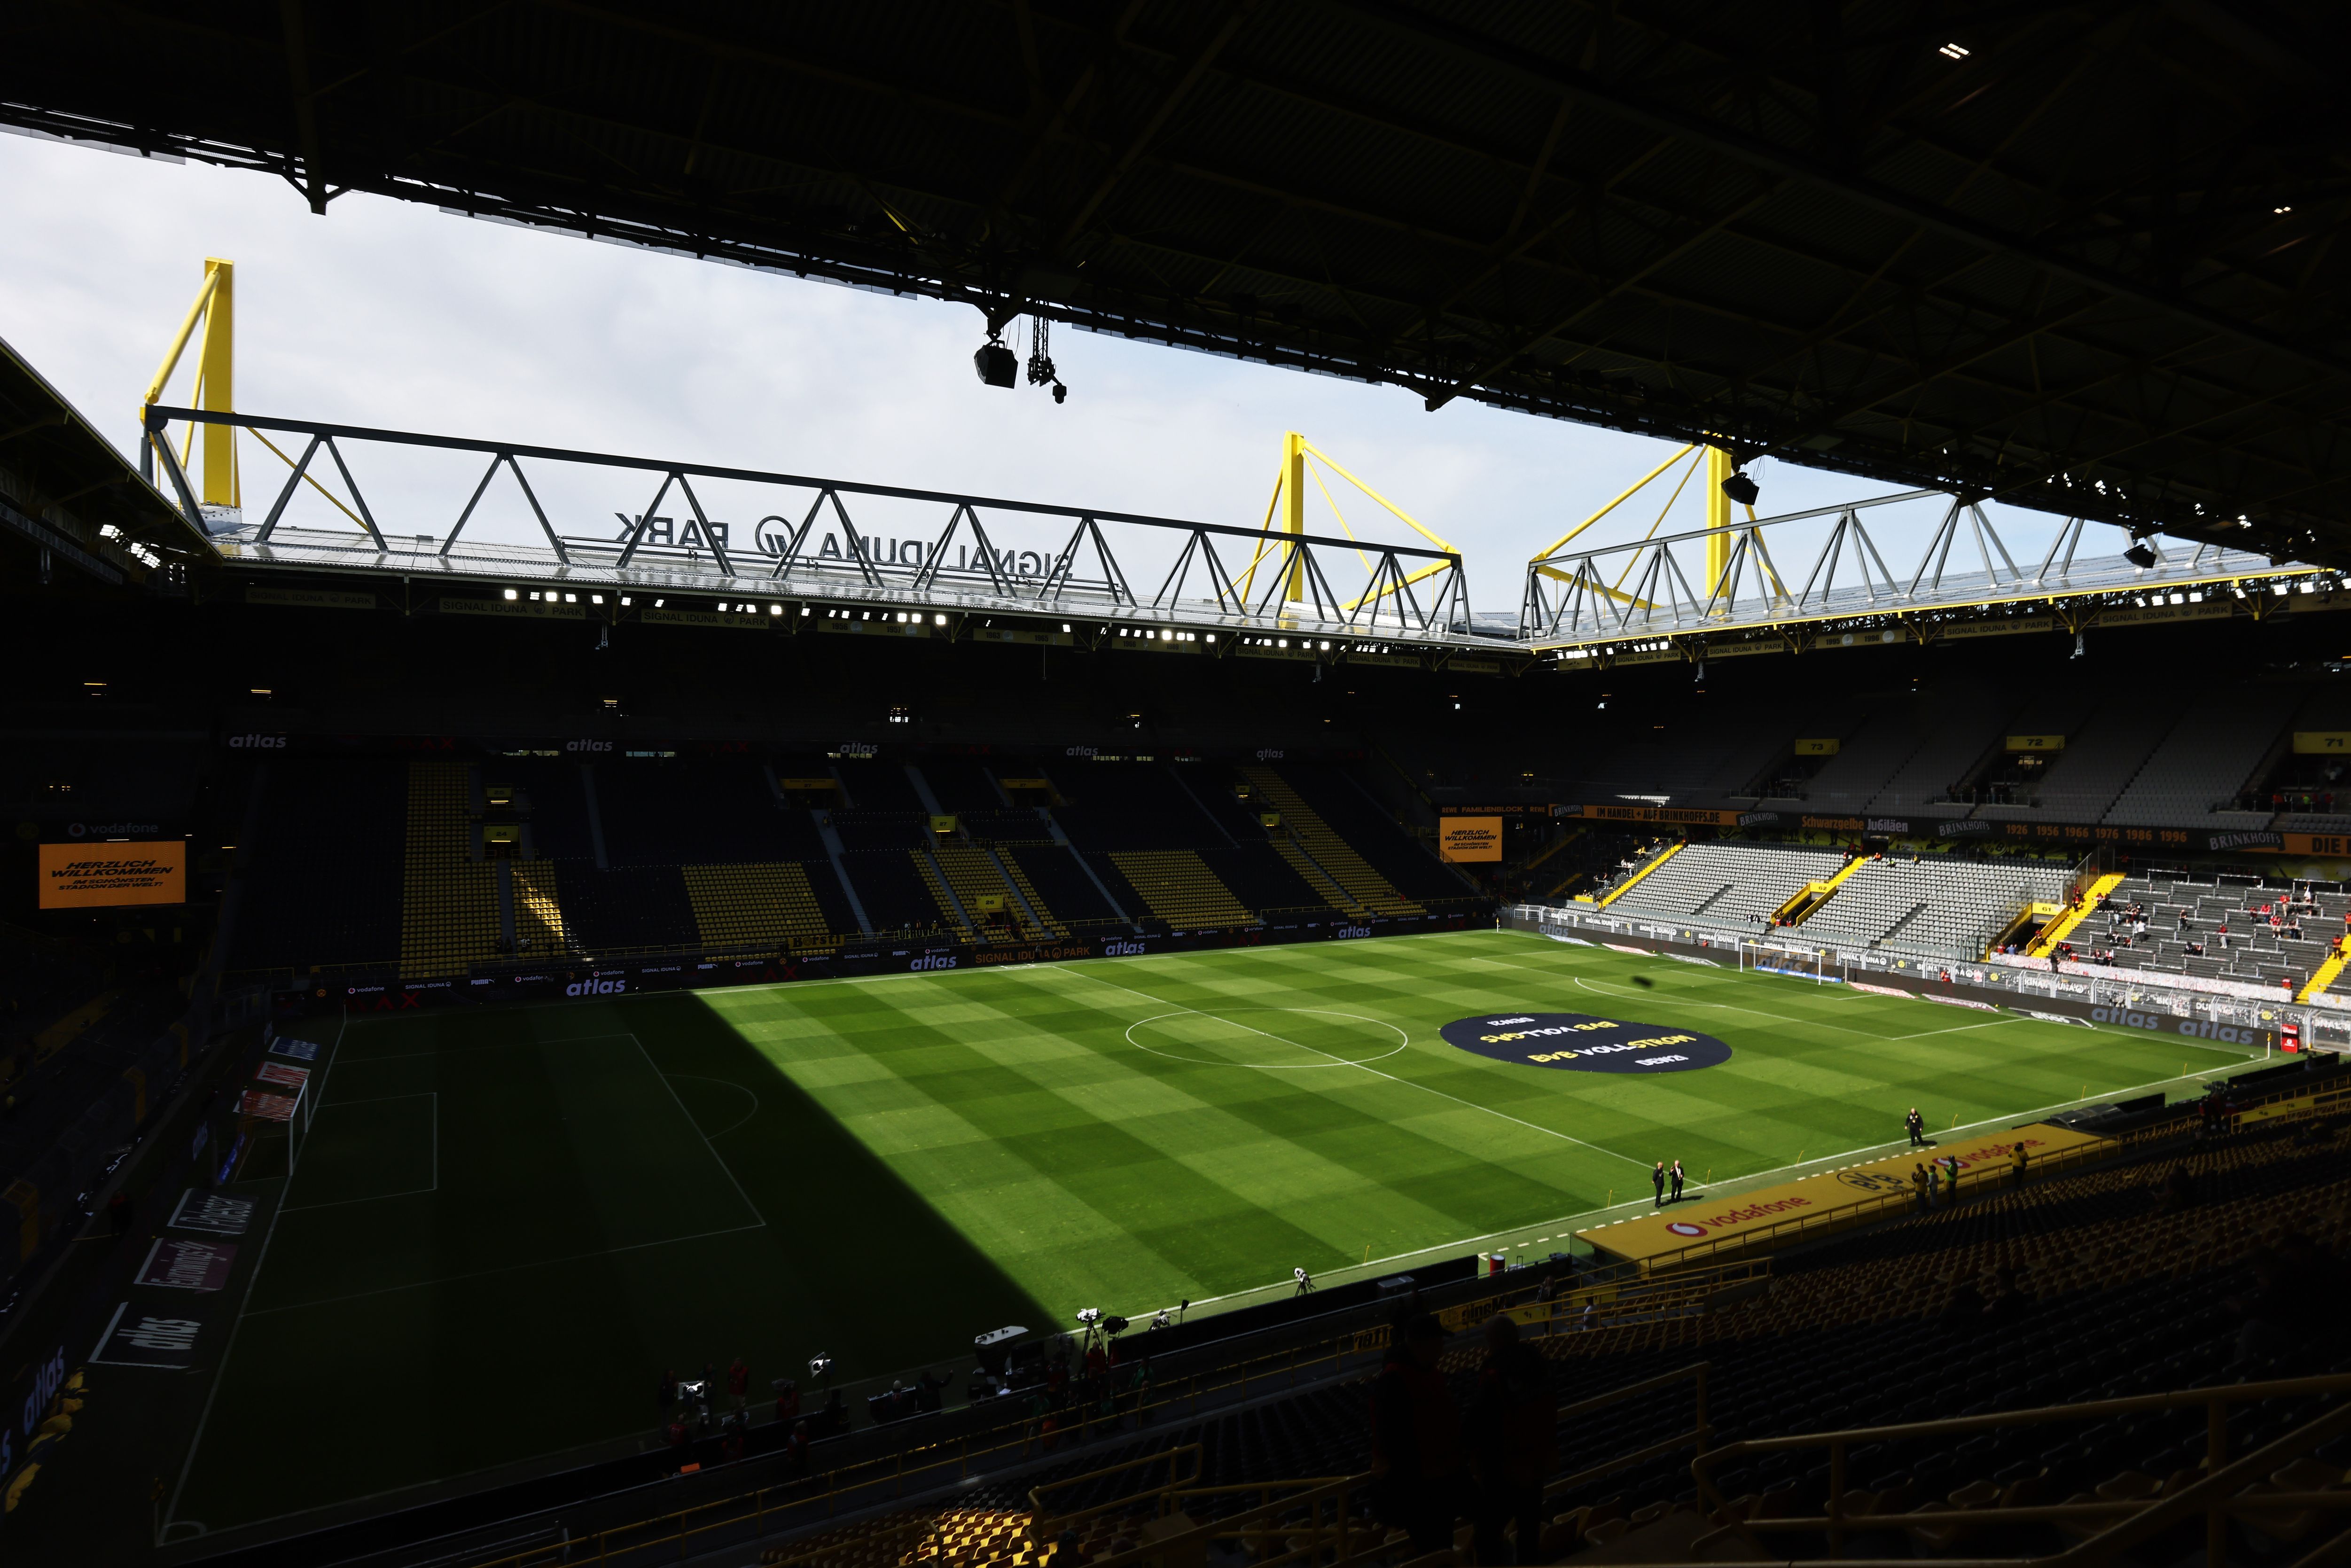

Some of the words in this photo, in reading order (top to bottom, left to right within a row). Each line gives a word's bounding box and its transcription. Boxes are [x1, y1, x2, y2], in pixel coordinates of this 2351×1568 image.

[250, 592, 289, 601] SIGNAL
[292, 593, 323, 602] IDUNA
[443, 602, 487, 611] SIGNAL
[491, 604, 527, 614] IDUNA
[552, 607, 582, 616] PARK
[2103, 612, 2140, 624] SIGNAL
[2143, 611, 2175, 620] IDUNA
[2198, 606, 2228, 616] PARK
[644, 612, 683, 622] SIGNAL
[687, 615, 718, 624] IDUNA
[739, 617, 766, 626] PARK
[1947, 626, 1977, 635] SIGNAL
[1980, 624, 2007, 633] IDUNA
[2025, 620, 2049, 629] PARK
[229, 734, 286, 748] atlas
[567, 739, 613, 751] atlas
[840, 742, 878, 754] atlas
[2325, 738, 2343, 747] 71
[1066, 746, 1098, 756] atlas
[1257, 749, 1284, 758] atlas
[1597, 808, 1606, 817] IM
[1607, 808, 1635, 819] HANDEL
[1643, 810, 1657, 820] AUF
[1659, 811, 1720, 823] BRINKHOFFS.DE
[90, 823, 158, 834] vodafone
[1802, 816, 1864, 830] Schwarzgelbe
[2006, 824, 2029, 835] 1926
[2037, 826, 2059, 836] 1956
[2065, 827, 2089, 838] 1966
[2095, 828, 2119, 840] 1976
[2126, 829, 2153, 841] 1986
[2160, 830, 2187, 843] 1996
[2312, 837, 2341, 854] DIE
[67, 860, 157, 869] HERZLICH
[52, 867, 174, 878] WILLKOMMEN
[1774, 910, 1785, 920] 62
[1338, 926, 1371, 939] atlas
[1539, 923, 1569, 937] atlas
[975, 952, 1015, 964] SIGNAL
[1063, 946, 1090, 957] PARK
[1105, 942, 1145, 957] atlas
[910, 955, 957, 971] atlas
[566, 979, 626, 997] atlas
[1573, 1021, 1620, 1031] BVB
[2091, 1008, 2159, 1030] atlas
[2179, 1020, 2254, 1044] atlas
[1527, 1050, 1579, 1062] BVB
[1573, 1034, 1697, 1056] VOLLSTROM
[179, 1194, 254, 1228] Polestar
[1699, 1197, 1812, 1227] vodafone
[150, 1249, 228, 1287] Eurowings
[117, 1316, 203, 1350] atlas
[23, 1344, 66, 1437] atlas
